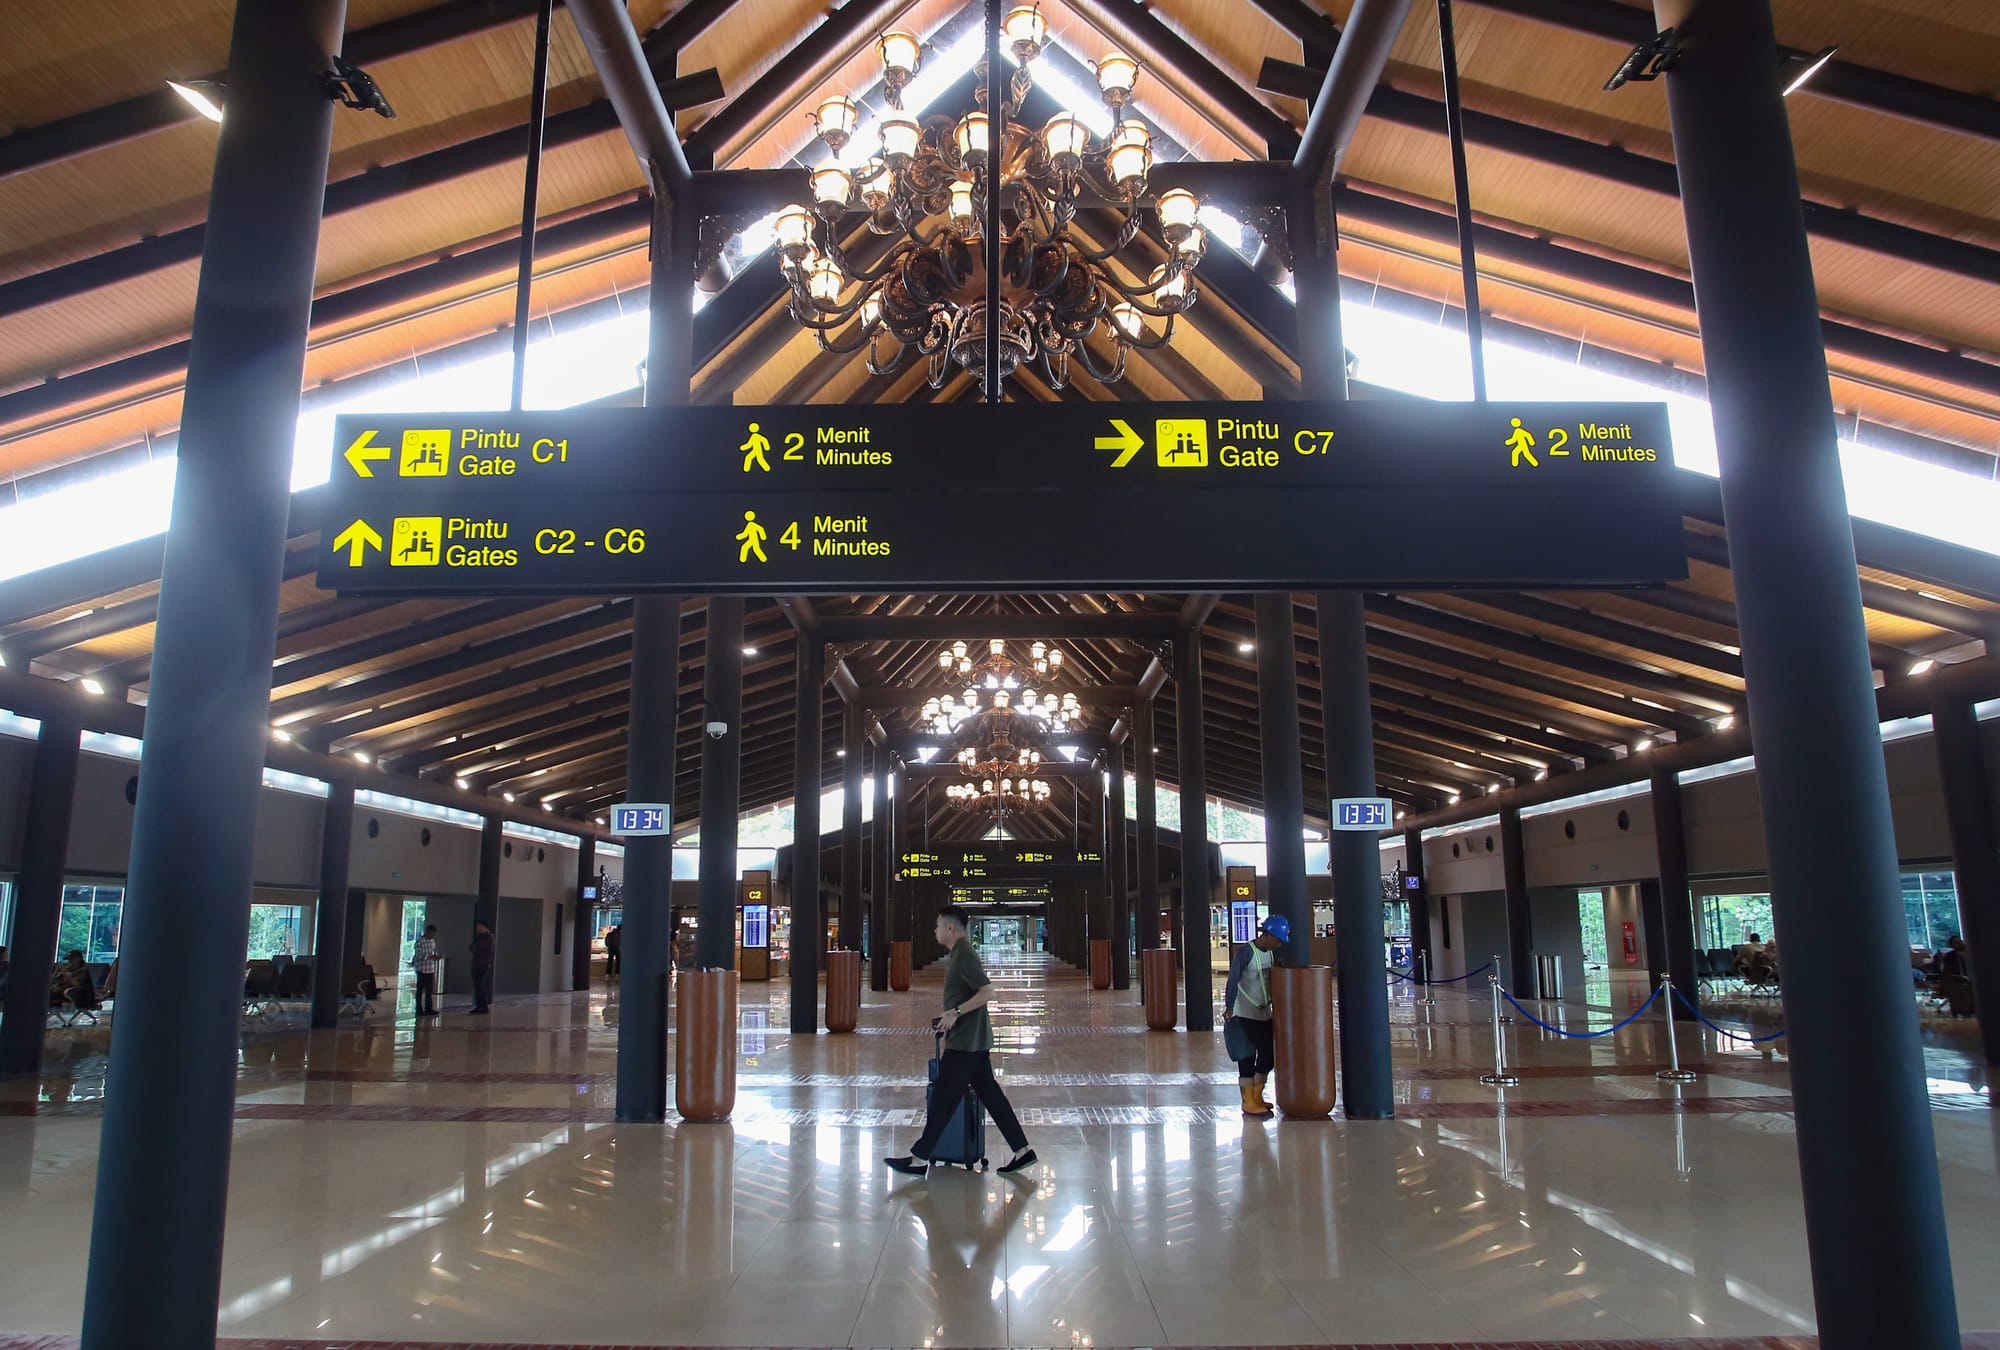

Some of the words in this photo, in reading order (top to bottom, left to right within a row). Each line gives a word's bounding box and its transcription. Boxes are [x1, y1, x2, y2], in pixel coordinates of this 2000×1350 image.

[460, 428, 521, 449] Pintu
[816, 427, 870, 444] Menit
[1217, 417, 1280, 440] Pintu
[1579, 423, 1631, 440] Menit
[531, 438, 568, 463] C1
[783, 432, 805, 461] 2
[1293, 430, 1335, 455] C7
[1548, 428, 1570, 456] 2
[1581, 444, 1657, 462] Minutes
[458, 454, 517, 476] Gate
[816, 448, 893, 465] Minutes
[1219, 445, 1280, 467] Gate
[447, 517, 508, 539] Pintu
[814, 515, 868, 533] Menit
[534, 528, 576, 555] C2
[604, 527, 645, 554] C6
[779, 521, 802, 551] 4
[813, 538, 891, 556] Minutes
[446, 544, 518, 567] Gates
[748, 890, 762, 900] C2
[1236, 886, 1250, 896] C6
